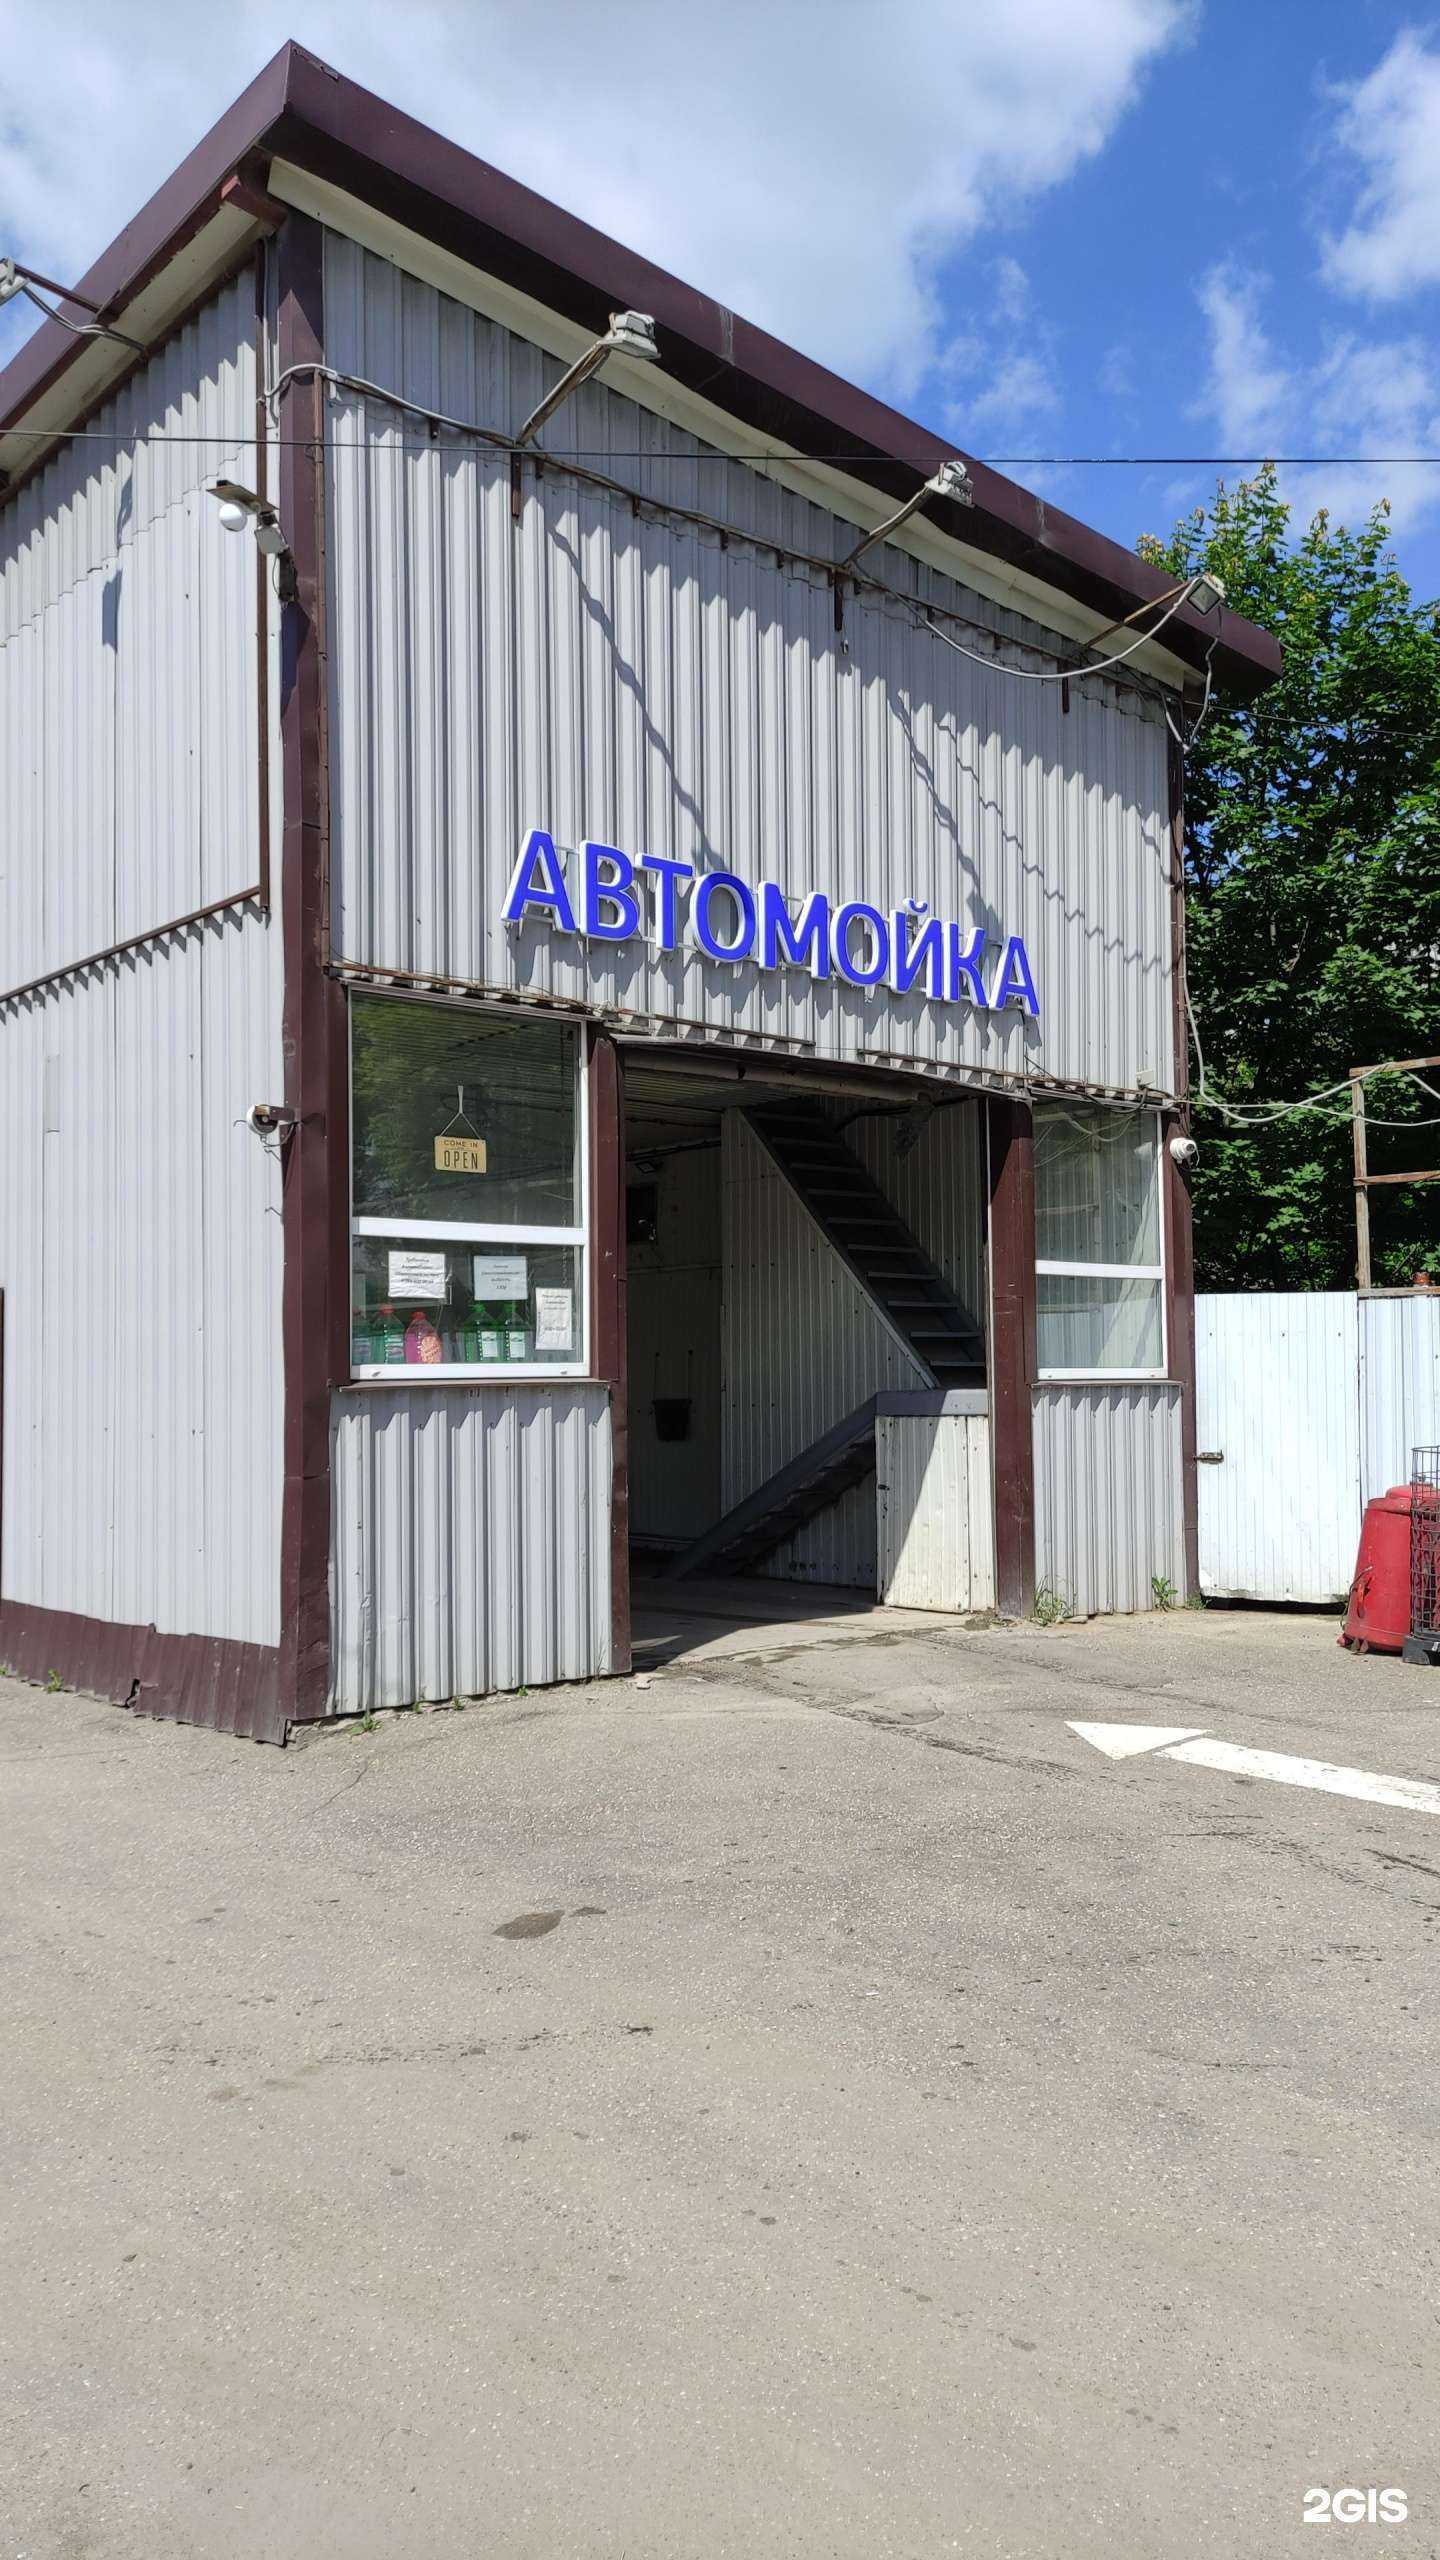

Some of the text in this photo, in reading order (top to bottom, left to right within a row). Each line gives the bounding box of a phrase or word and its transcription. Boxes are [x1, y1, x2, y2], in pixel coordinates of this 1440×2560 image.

[501, 829, 1040, 1017] АВТОМОЙКА
[443, 1139, 465, 1147] COME
[444, 1150, 478, 1170] OPEN
